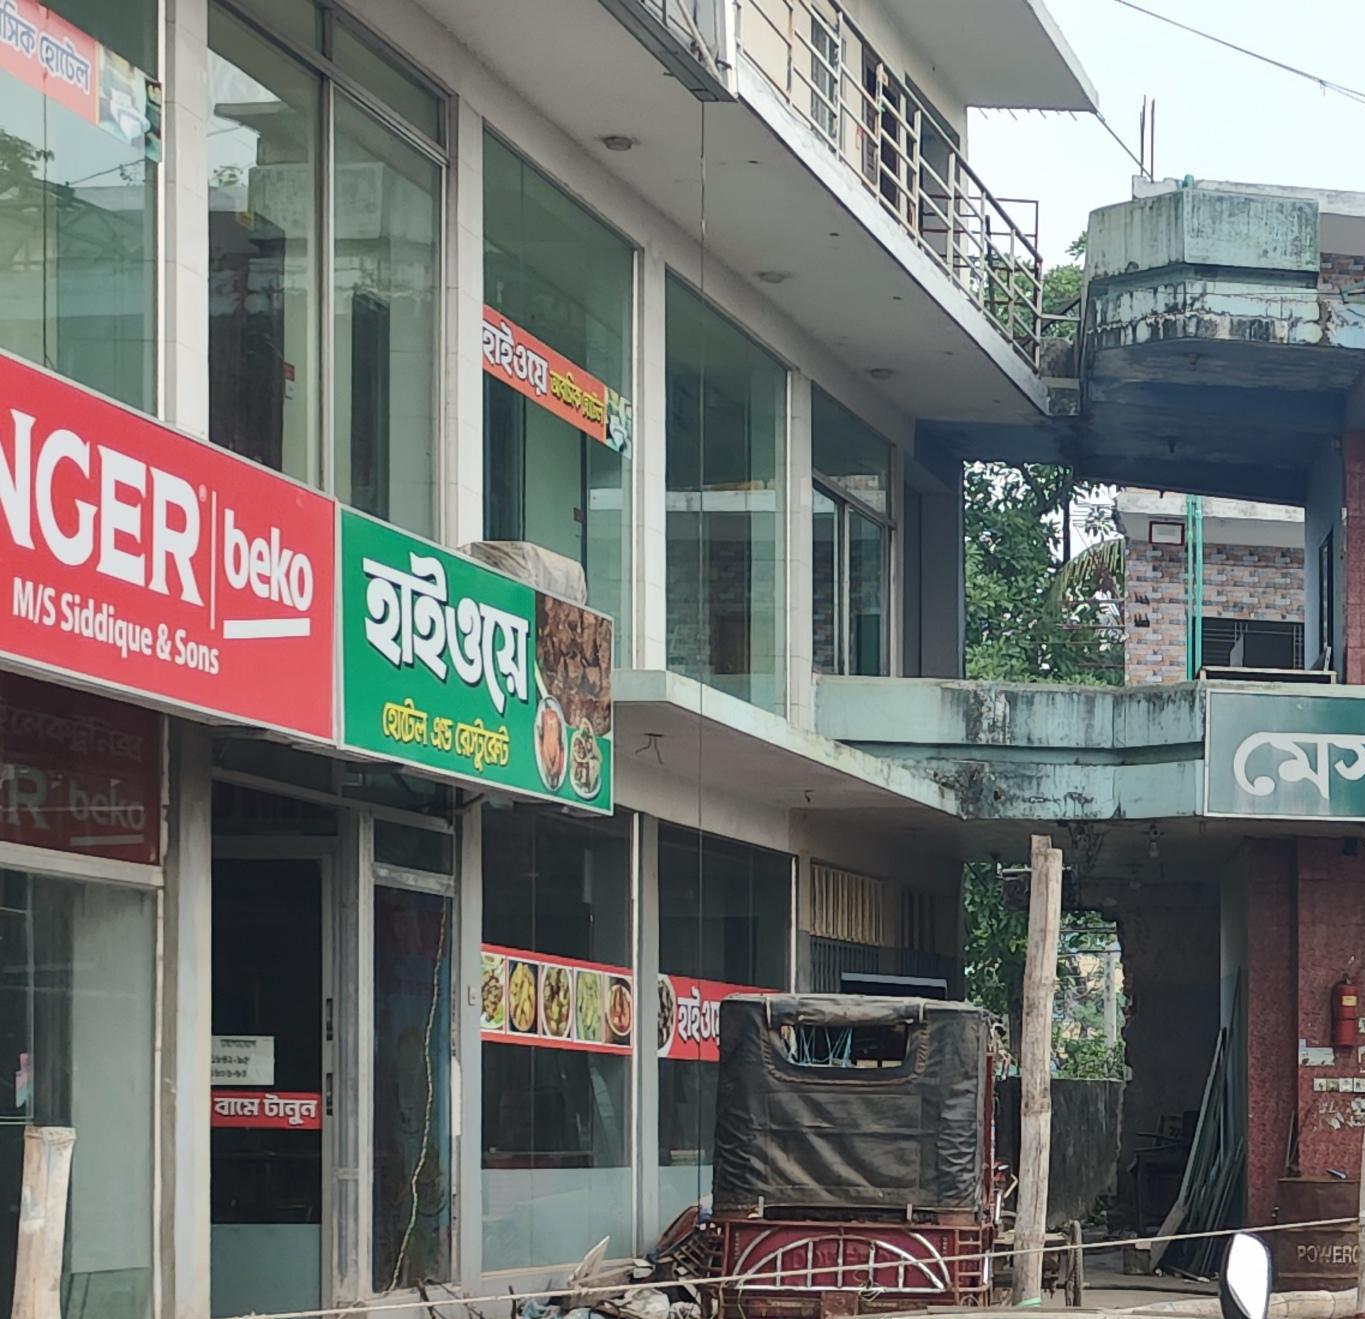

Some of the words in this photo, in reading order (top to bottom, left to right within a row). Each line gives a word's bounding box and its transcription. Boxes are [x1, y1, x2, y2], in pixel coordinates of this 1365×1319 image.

[0, 0, 36, 58] সিক
[39, 33, 91, 94] হোটেল
[483, 319, 549, 396] হাইওয়ে
[0, 408, 204, 607] NGER
[224, 509, 313, 612] beko
[13, 576, 57, 630] M/S
[61, 591, 153, 656] Siddique
[157, 619, 172, 649] &
[175, 624, 219, 675] Sons
[362, 553, 530, 715] হাইওয়ে
[382, 697, 429, 745] হোটেল
[213, 1097, 260, 1116] বামে
[263, 1093, 318, 1125] টানুন
